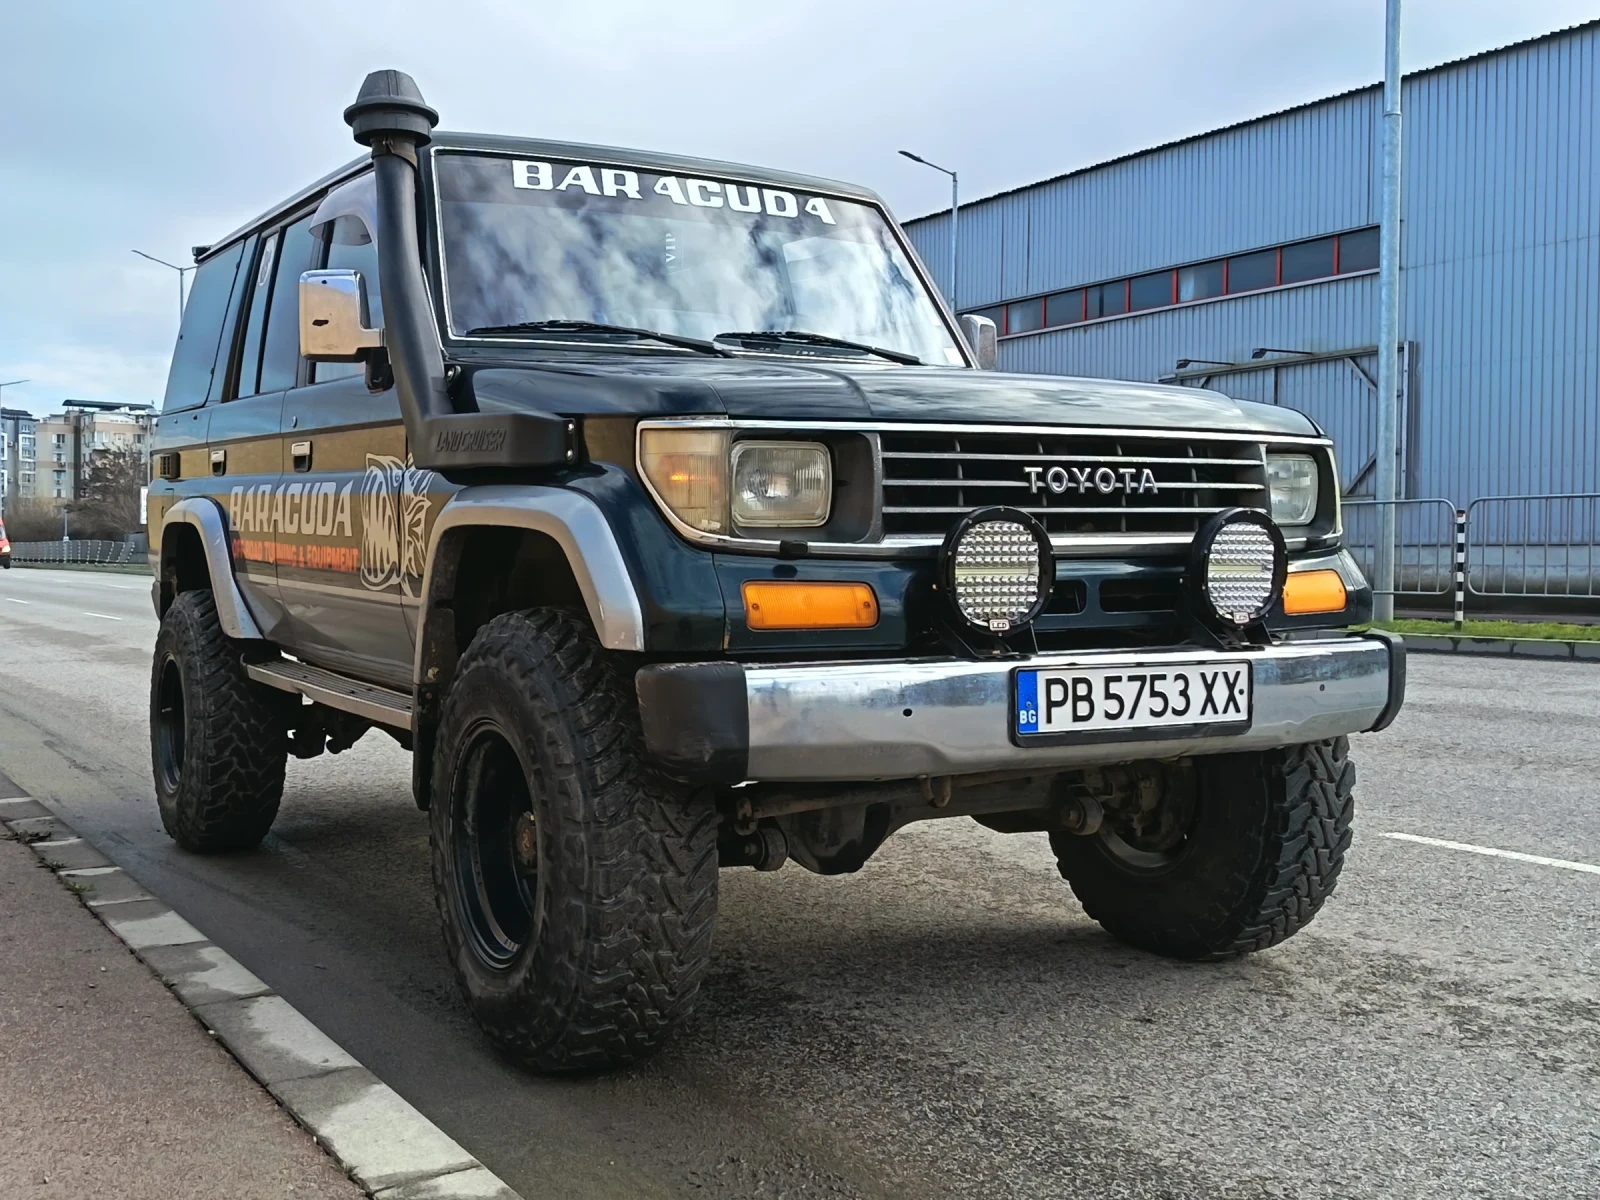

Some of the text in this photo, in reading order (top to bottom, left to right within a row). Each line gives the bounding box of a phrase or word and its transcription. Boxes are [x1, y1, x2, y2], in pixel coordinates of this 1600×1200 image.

[511, 159, 836, 225] BARACUDA
[1023, 466, 1159, 494] TOYOTA
[229, 478, 354, 538] BARACUDA
[306, 544, 359, 572] EQUIPMENT
[1019, 710, 1038, 725] BG
[1045, 671, 1242, 725] PB 5753 XX
